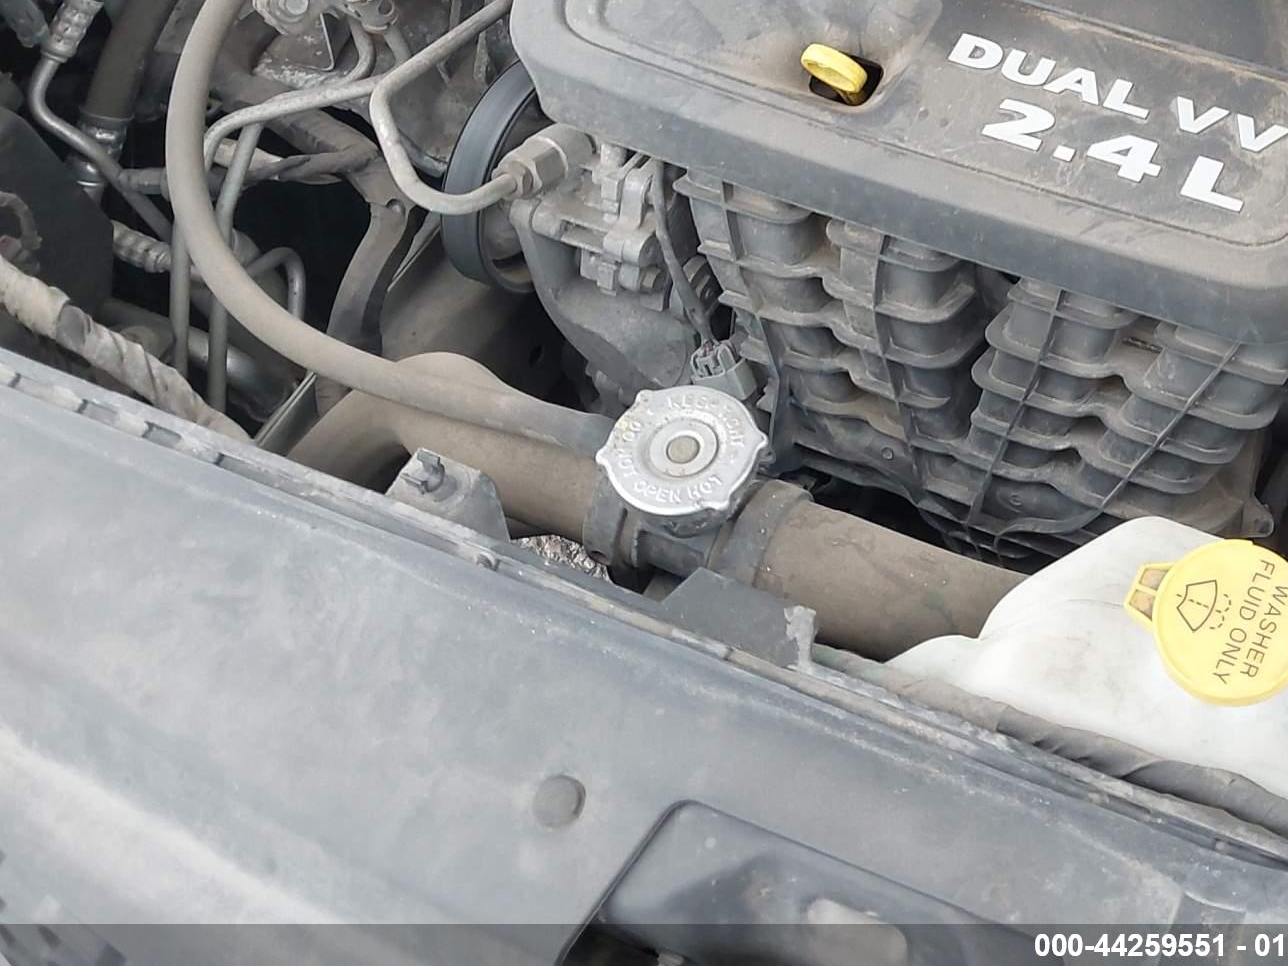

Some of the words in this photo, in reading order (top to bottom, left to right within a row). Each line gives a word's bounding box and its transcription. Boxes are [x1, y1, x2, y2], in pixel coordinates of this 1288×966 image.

[947, 32, 1150, 120] DUAL
[982, 99, 1161, 183] 2.4
[1180, 155, 1245, 212] L
[635, 480, 681, 503] OPEN
[687, 474, 722, 499] HOT
[1238, 558, 1275, 622] FLUID
[1211, 628, 1248, 685] ONLY
